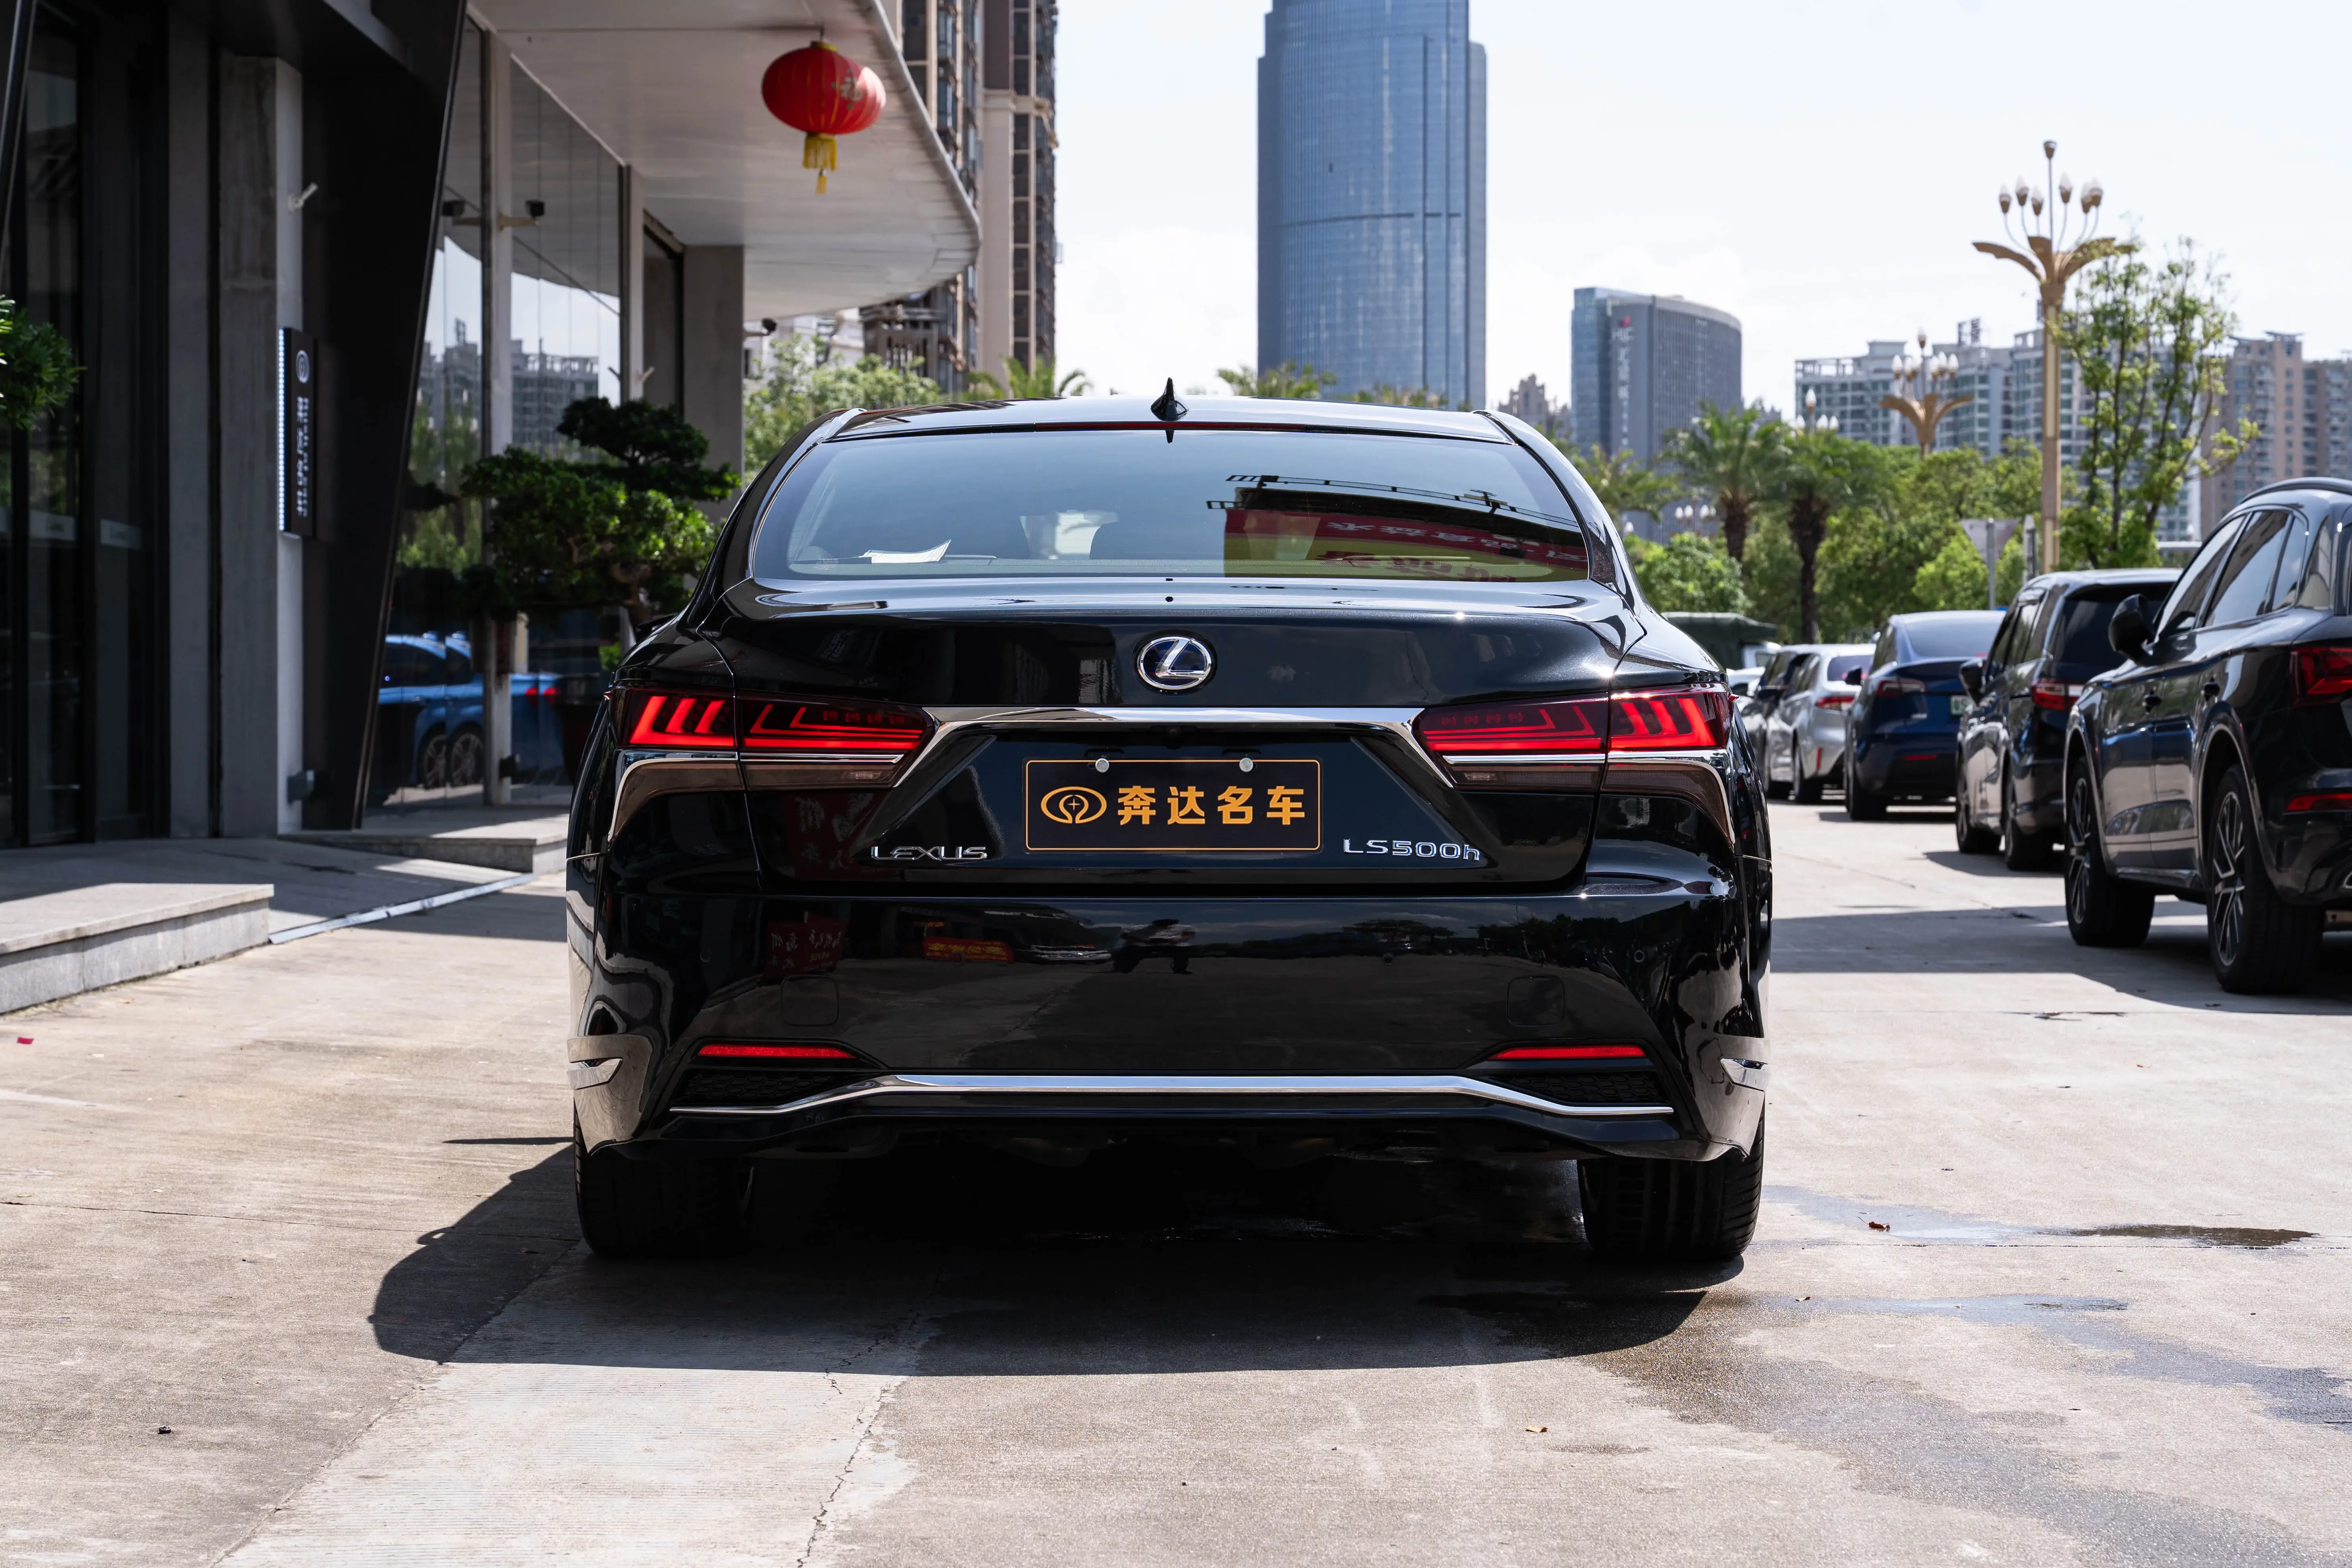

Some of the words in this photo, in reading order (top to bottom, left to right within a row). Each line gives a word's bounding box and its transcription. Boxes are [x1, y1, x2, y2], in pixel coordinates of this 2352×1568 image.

[1118, 785, 1305, 825] 奔达名车
[871, 846, 987, 861] LEXUS
[1344, 838, 1480, 861] LS500h
